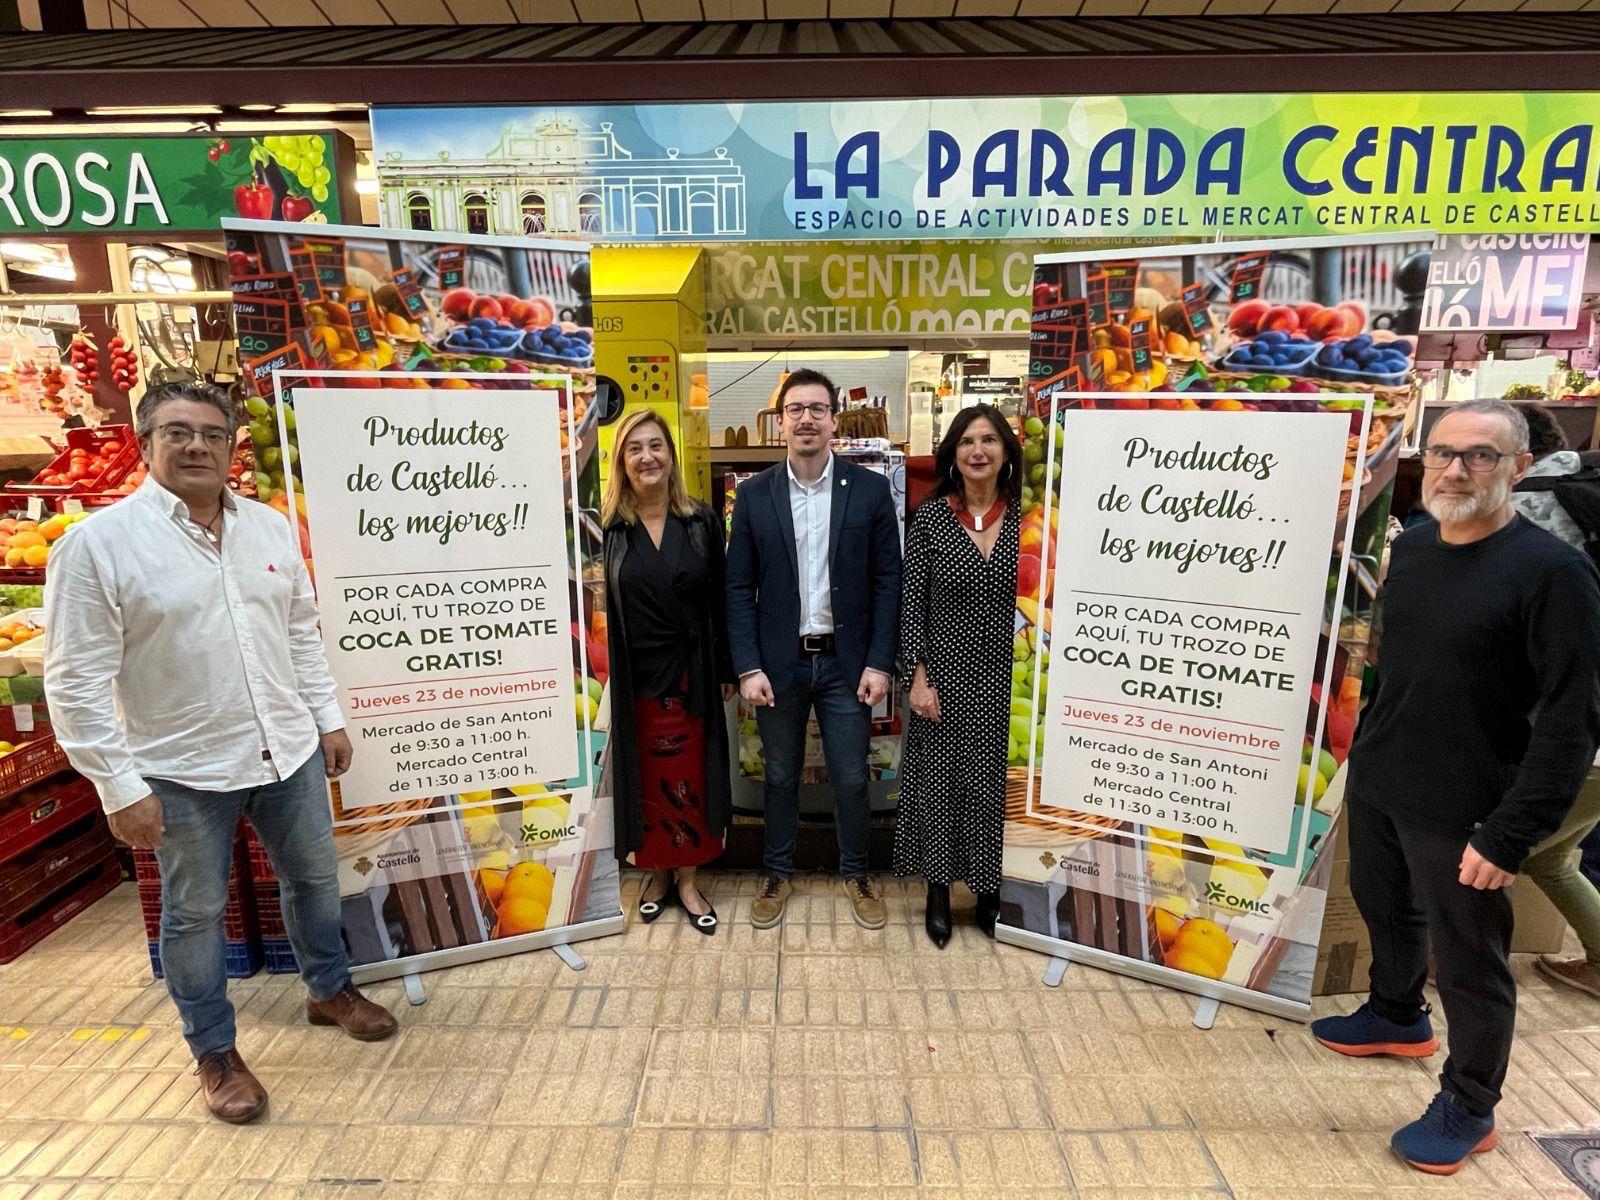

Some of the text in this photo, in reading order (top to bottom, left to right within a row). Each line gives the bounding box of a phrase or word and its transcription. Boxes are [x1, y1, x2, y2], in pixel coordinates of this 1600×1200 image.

[794, 124, 1600, 199] LA PARADA CENTRA
[795, 204, 1600, 230] ESPACIO DE ACTIVIDADES DEL MERCAT CENTRAL DE CASTELL
[711, 254, 810, 300] RCAT
[821, 253, 990, 298] CENTRAL
[706, 308, 754, 333] RAL
[762, 298, 901, 333] CASTELLÓ
[910, 308, 1031, 332] merc
[364, 416, 509, 452] Productos
[1124, 437, 1279, 480] Productos
[347, 464, 383, 492] de
[1098, 484, 1132, 512] de
[359, 503, 528, 545] los mejores!!
[1100, 528, 1286, 574] los mejores!!
[344, 577, 547, 602] POR CADA COMPRA
[349, 597, 545, 625] AQUÍ, TU TROZO DE
[1076, 602, 1290, 639] POR CADA COMPRA
[339, 619, 558, 651] COCA DE TOMATE
[1075, 624, 1285, 662] AQUÍ, TU TROZO DE
[407, 650, 502, 672] GRATIS!
[1064, 646, 1295, 692] COCA DE TOMATE
[351, 680, 556, 710] Jueves 23 de noviembre
[1121, 680, 1222, 709] GRATIS!
[362, 707, 551, 739] Mercado de San Antoni
[1064, 705, 1280, 750] Jueves 23 de noviembre
[390, 727, 531, 754] de 9:30 a 11:00 h.
[397, 746, 527, 772] Mercado Central
[1069, 735, 1268, 780] Mercado de San Antoni
[390, 764, 537, 792] de 11:30 a 13:00 h.
[1091, 758, 1237, 794] de 9:30 a 11:00 h.
[1093, 776, 1230, 813] Mercado Central
[1083, 793, 1238, 834] de 11:30 a 13:00 h.
[540, 826, 576, 840] OMIC
[377, 854, 420, 868] Castelló
[1060, 860, 1100, 877] Castelló
[1226, 895, 1270, 914] OMIC
